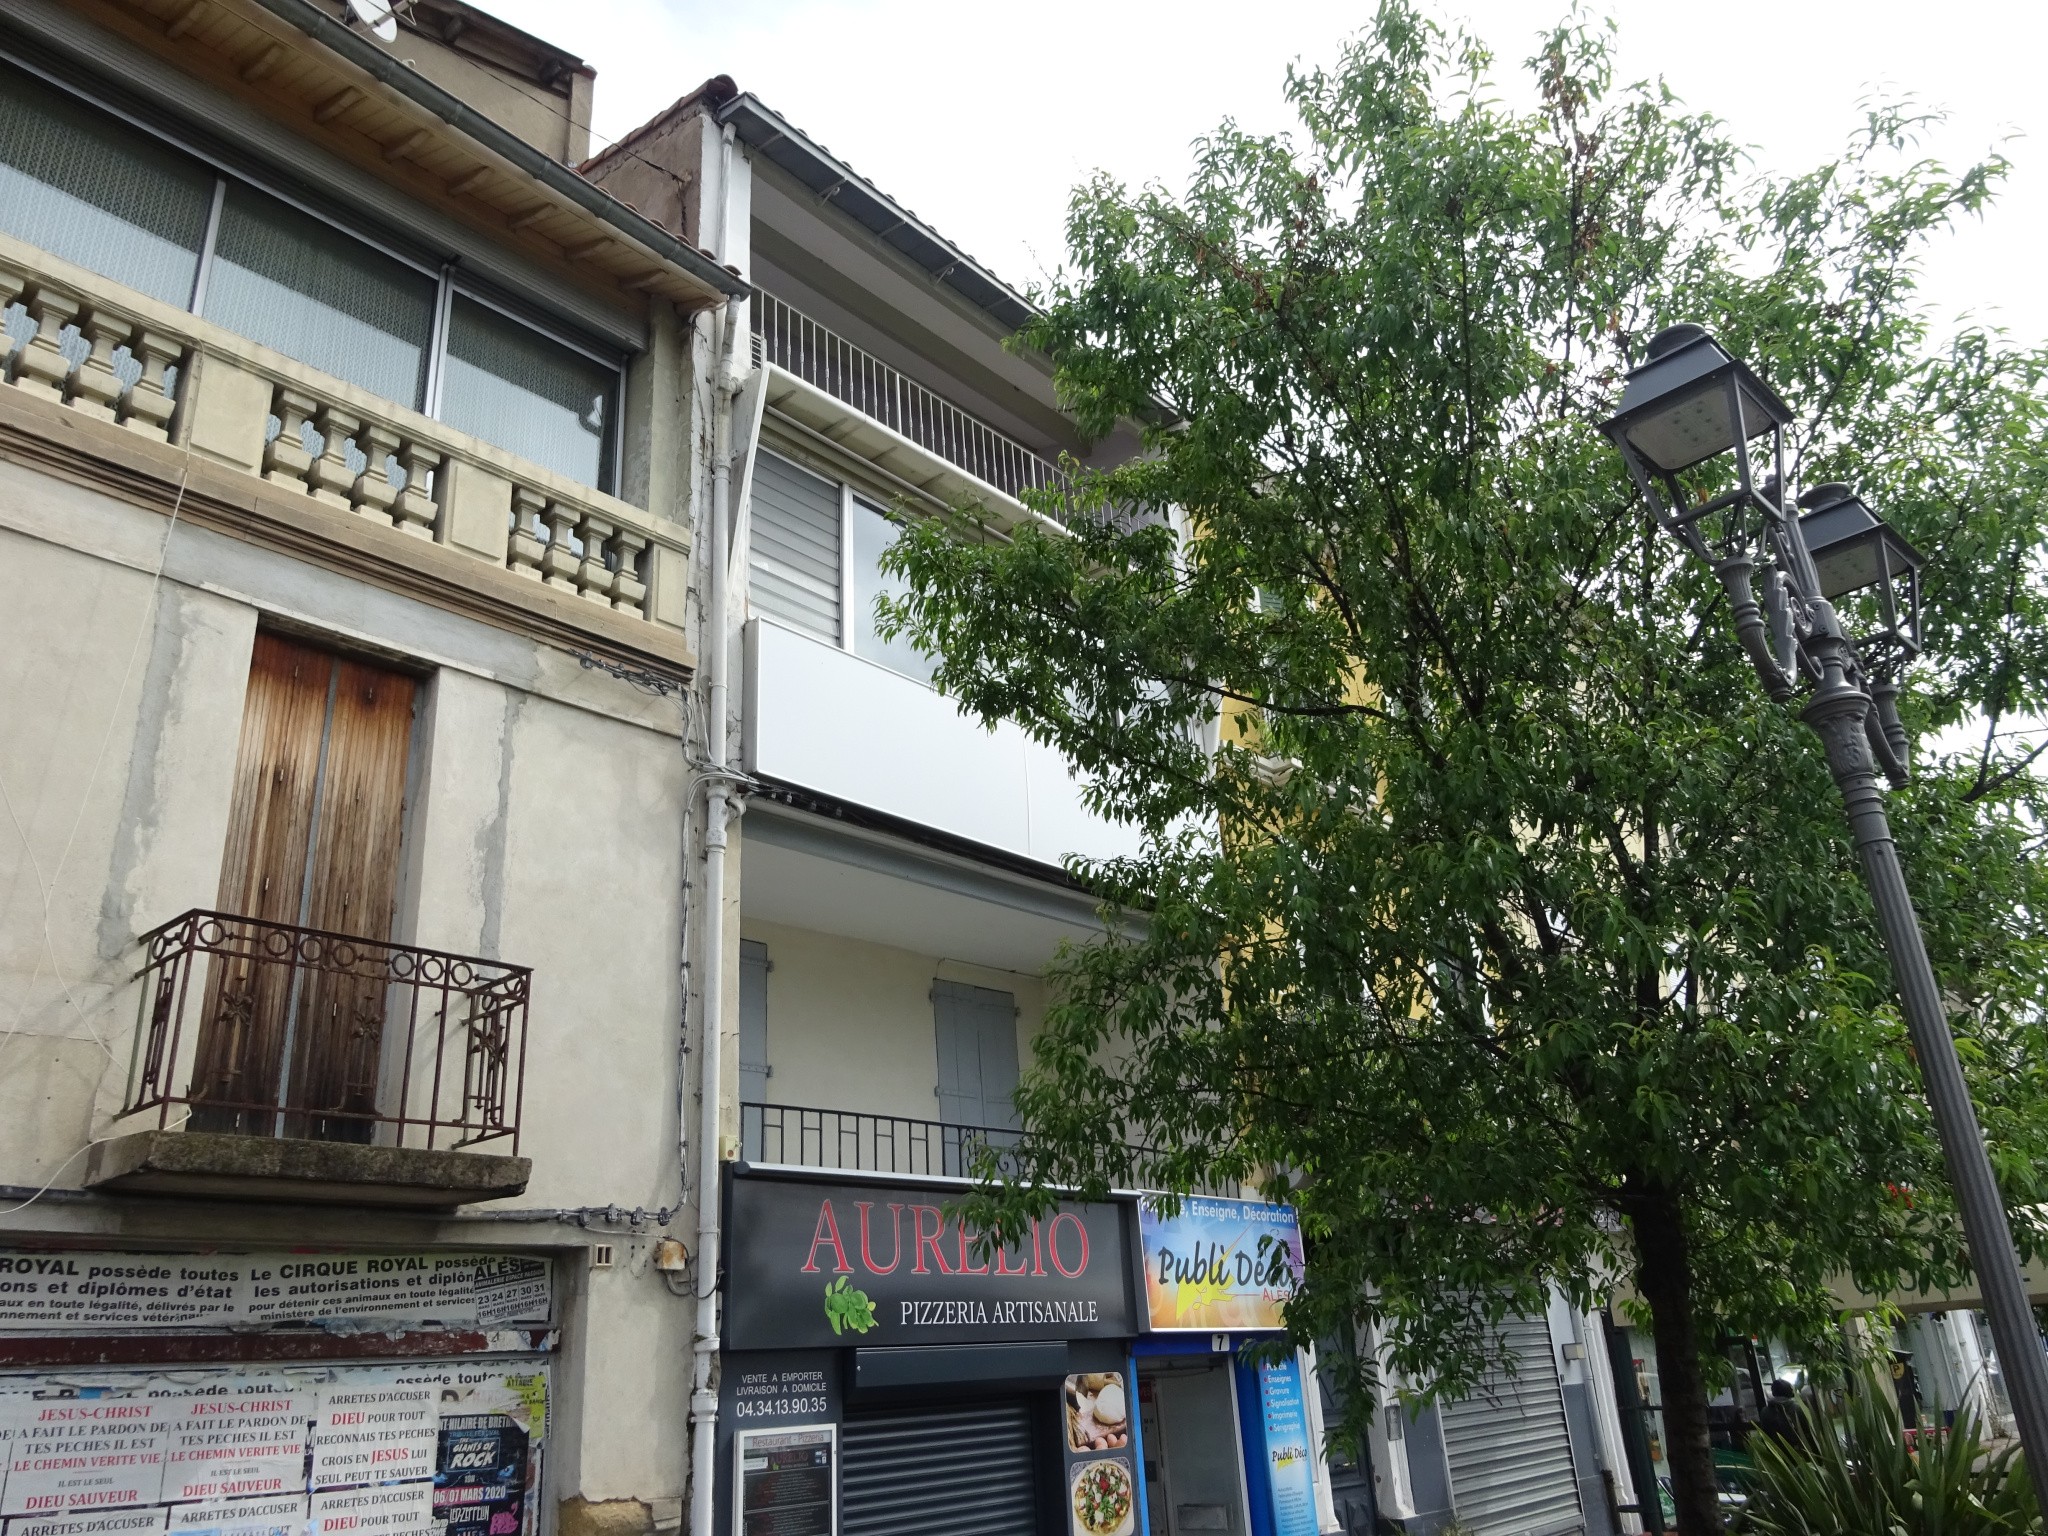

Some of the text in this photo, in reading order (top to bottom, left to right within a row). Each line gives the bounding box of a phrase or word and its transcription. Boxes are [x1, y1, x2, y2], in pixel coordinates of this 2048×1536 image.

[1192, 1200, 1240, 1222] Enseigne,
[1243, 1205, 1295, 1224] Décoration
[800, 1198, 1090, 1279] AURELIO
[0, 1257, 239, 1281] ROYAL possède toutes
[251, 1269, 272, 1281] Le
[280, 1261, 358, 1279] CIRQUE
[367, 1257, 428, 1273] ROYAL
[48, 1281, 68, 1293] et
[78, 1281, 169, 1298] diplômes
[177, 1284, 232, 1298] d'état
[255, 1285, 280, 1297] les
[288, 1276, 400, 1295] autorisations
[406, 1274, 422, 1286] et
[506, 1288, 518, 1298] 27
[521, 1286, 532, 1295] 30
[534, 1283, 545, 1293] 31
[249, 1302, 273, 1313] pour
[279, 1298, 320, 1309] détenir
[323, 1296, 342, 1305] ces
[345, 1293, 391, 1303] animaux
[394, 1292, 406, 1300] en
[410, 1288, 436, 1299] toute
[478, 1295, 490, 1305] 23
[492, 1292, 503, 1302] 24
[50, 1300, 85, 1309] toute
[89, 1300, 142, 1312] légalité,
[146, 1301, 196, 1312] délivrés
[200, 1303, 219, 1314] par
[223, 1304, 234, 1312] le
[261, 1309, 315, 1321] ministère
[319, 1308, 331, 1316] de
[335, 1301, 420, 1315] l'environnement
[422, 1299, 433, 1308] et
[900, 1300, 1099, 1325] PIZZERIA ARTISANALE
[66, 1312, 79, 1320] et
[84, 1312, 138, 1321] services
[1217, 1334, 1224, 1350] 7
[742, 1371, 823, 1384] VENTE A EMPORTER
[1267, 1375, 1292, 1385] Enseignes
[736, 1382, 827, 1396] LIVRAISON A DOMICILE
[1269, 1387, 1290, 1395] Gravure
[328, 1393, 376, 1405] ARRETES
[378, 1391, 431, 1402] D'ACCUSER
[1270, 1398, 1300, 1409] Signalisation
[38, 1405, 153, 1421] JESUS-CHRIST
[190, 1400, 293, 1415] JESUS-CHRIST
[736, 1396, 827, 1417] 04.34.13.90.35
[173, 1415, 307, 1432] A FAIT LE PARDON DE
[331, 1411, 425, 1425] DIEU POUR TOUT
[18, 1422, 169, 1438] A FAIT LE PARDON DE
[180, 1430, 297, 1446] TES PECHES IL EST
[316, 1432, 376, 1445] RECONNAIS
[379, 1431, 396, 1441] TES
[399, 1428, 435, 1440] PECHES
[25, 1438, 156, 1454] TES PECHES IL EST
[453, 1441, 495, 1452] GIANTS OF
[752, 1432, 824, 1447] Restaurant Pizzeria
[171, 1444, 301, 1462] LE CHEMIN VERITE VIE
[321, 1448, 427, 1466] CROIS EN JESUS LUI
[450, 1452, 497, 1469] ROCK
[15, 1453, 161, 1472] LE CHEMIN VERITE VIE
[233, 1468, 242, 1476] LE
[243, 1467, 260, 1475] SEUL
[315, 1466, 428, 1485] SEUL PEUT TE SAUVER
[68, 1479, 82, 1487] EST
[95, 1477, 114, 1485] SEUL
[182, 1478, 282, 1497] DIEU SAUVEUR
[25, 1489, 138, 1509] DIEU SAUVEUR
[320, 1490, 424, 1510] ARRETES D'ACCUSER
[461, 1488, 484, 1501] MARS
[485, 1486, 506, 1499] 2020
[181, 1502, 298, 1523] ARRETES D'ACCUSER
[20, 1516, 154, 1536] ARRETES D'ACCUSER
[323, 1512, 420, 1531] DIEU POUR TOUT
